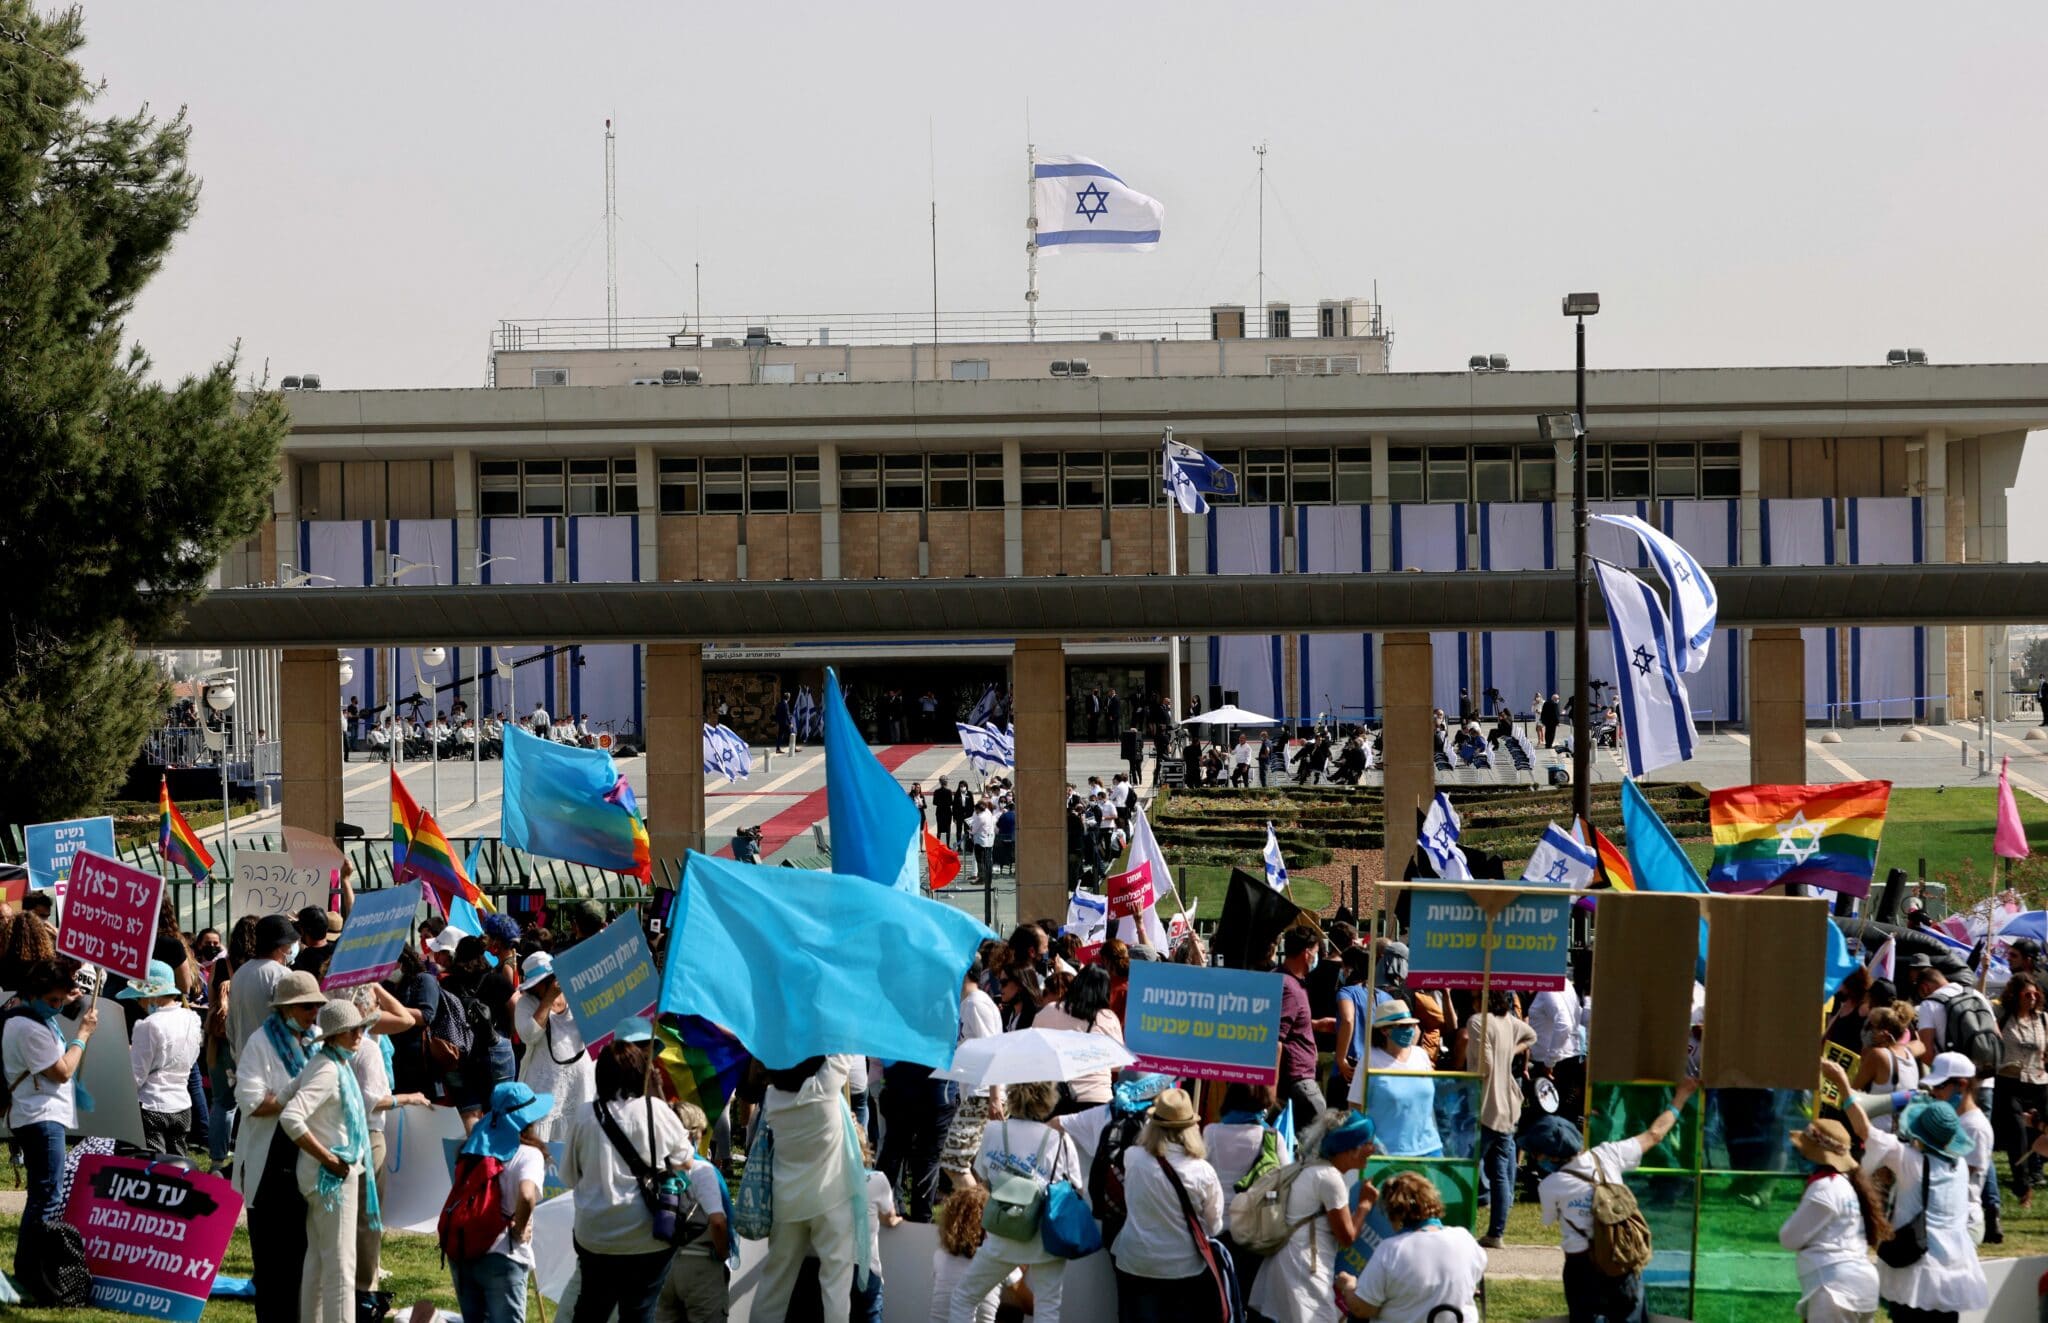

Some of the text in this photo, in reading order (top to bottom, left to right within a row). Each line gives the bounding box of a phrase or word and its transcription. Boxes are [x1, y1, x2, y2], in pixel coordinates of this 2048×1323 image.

[55, 827, 84, 840] נשים
[56, 840, 86, 853] שלום
[77, 857, 150, 908] עד כאן!
[72, 901, 144, 936] לא מחליטים
[1505, 904, 1536, 926] חלון
[1540, 908, 1559, 923] יש
[65, 928, 138, 969] בלי נשים
[1426, 931, 1477, 949] שכנינו!
[1505, 933, 1557, 951] להסכם
[1142, 987, 1270, 1015] יש חלון הזדמנויות
[1141, 1013, 1268, 1042] להסכם עם שכנינו!
[1201, 1068, 1219, 1076] שלום
[108, 1173, 188, 1207] עד כאן!
[88, 1206, 187, 1242] בכנסת הבאה
[88, 1235, 215, 1281] לא מחליטים בלי
[133, 1292, 172, 1313] נשים
